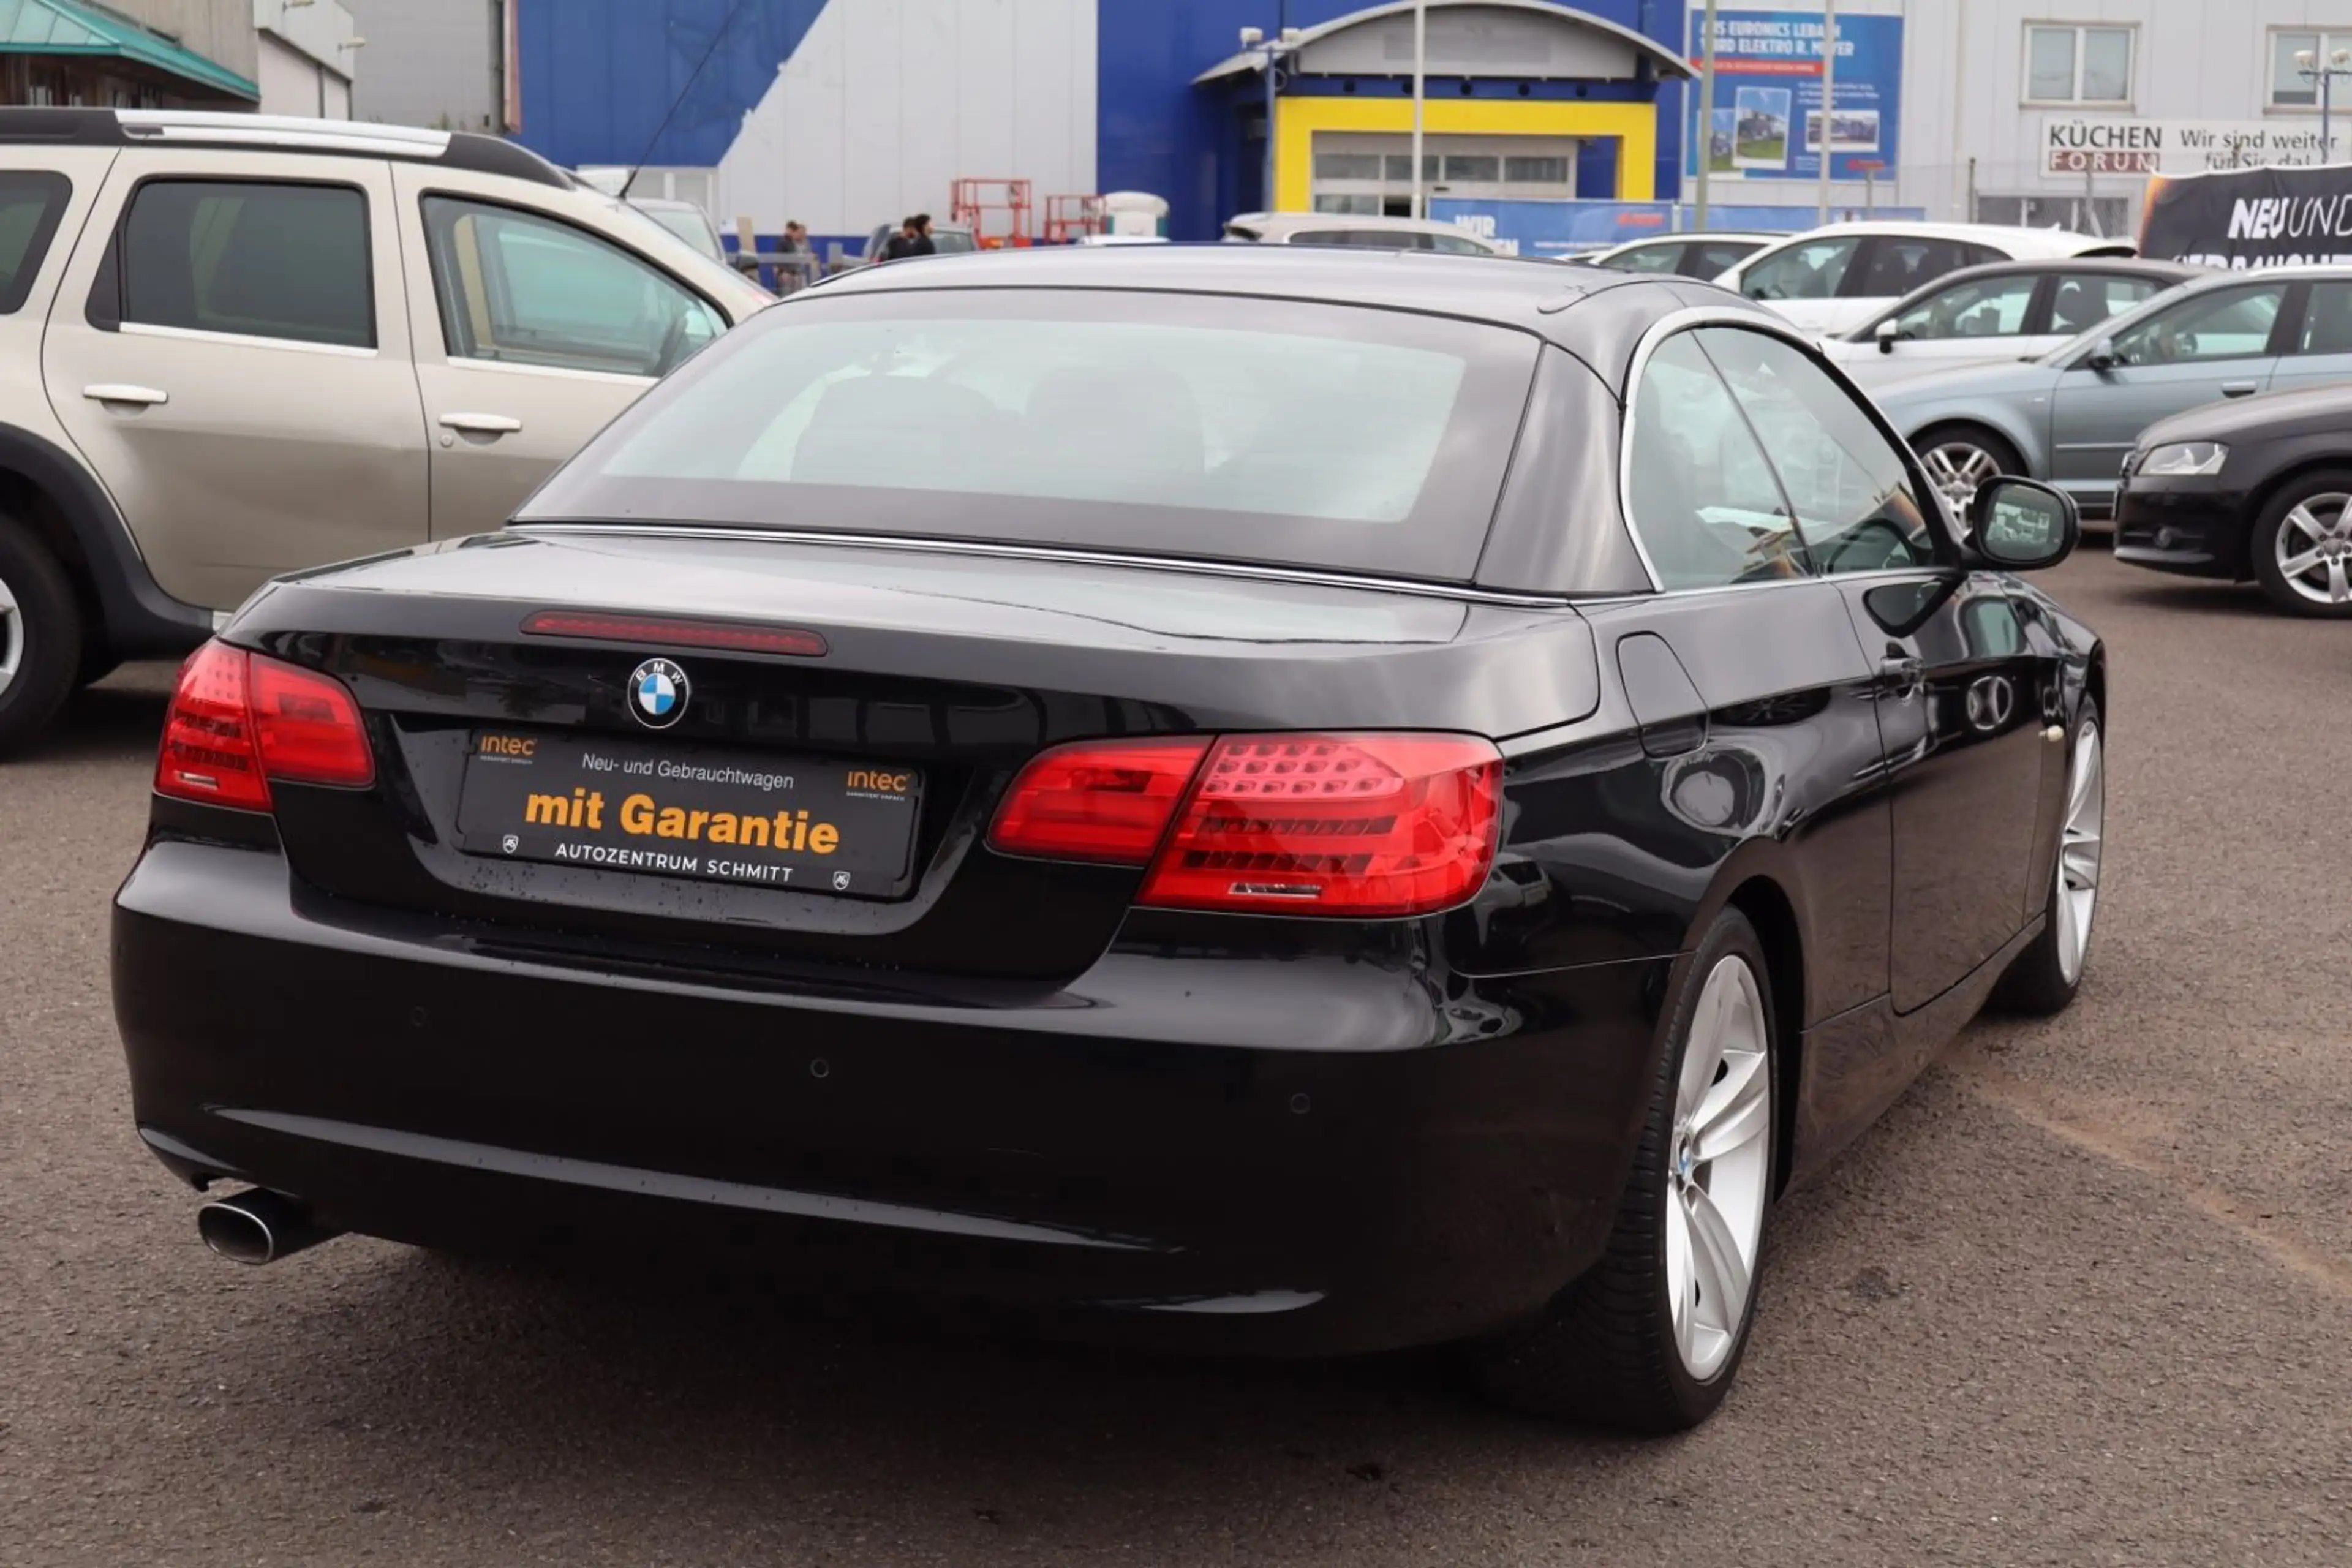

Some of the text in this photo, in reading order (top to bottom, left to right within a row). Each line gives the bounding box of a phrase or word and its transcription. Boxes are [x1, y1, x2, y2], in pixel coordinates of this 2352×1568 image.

[2050, 119, 2162, 148] KÜCHEN
[2180, 129, 2215, 148] Wir
[2222, 128, 2266, 148] sind
[2051, 152, 2158, 171] FORUM
[636, 662, 683, 685] BMW
[480, 734, 535, 755] intec
[582, 752, 794, 791] Neu- und Gebrauchtwagen
[847, 770, 907, 792] intec
[525, 787, 840, 854] mit Garantie
[554, 842, 794, 882] AUTOZENTRUM SCHMITT
